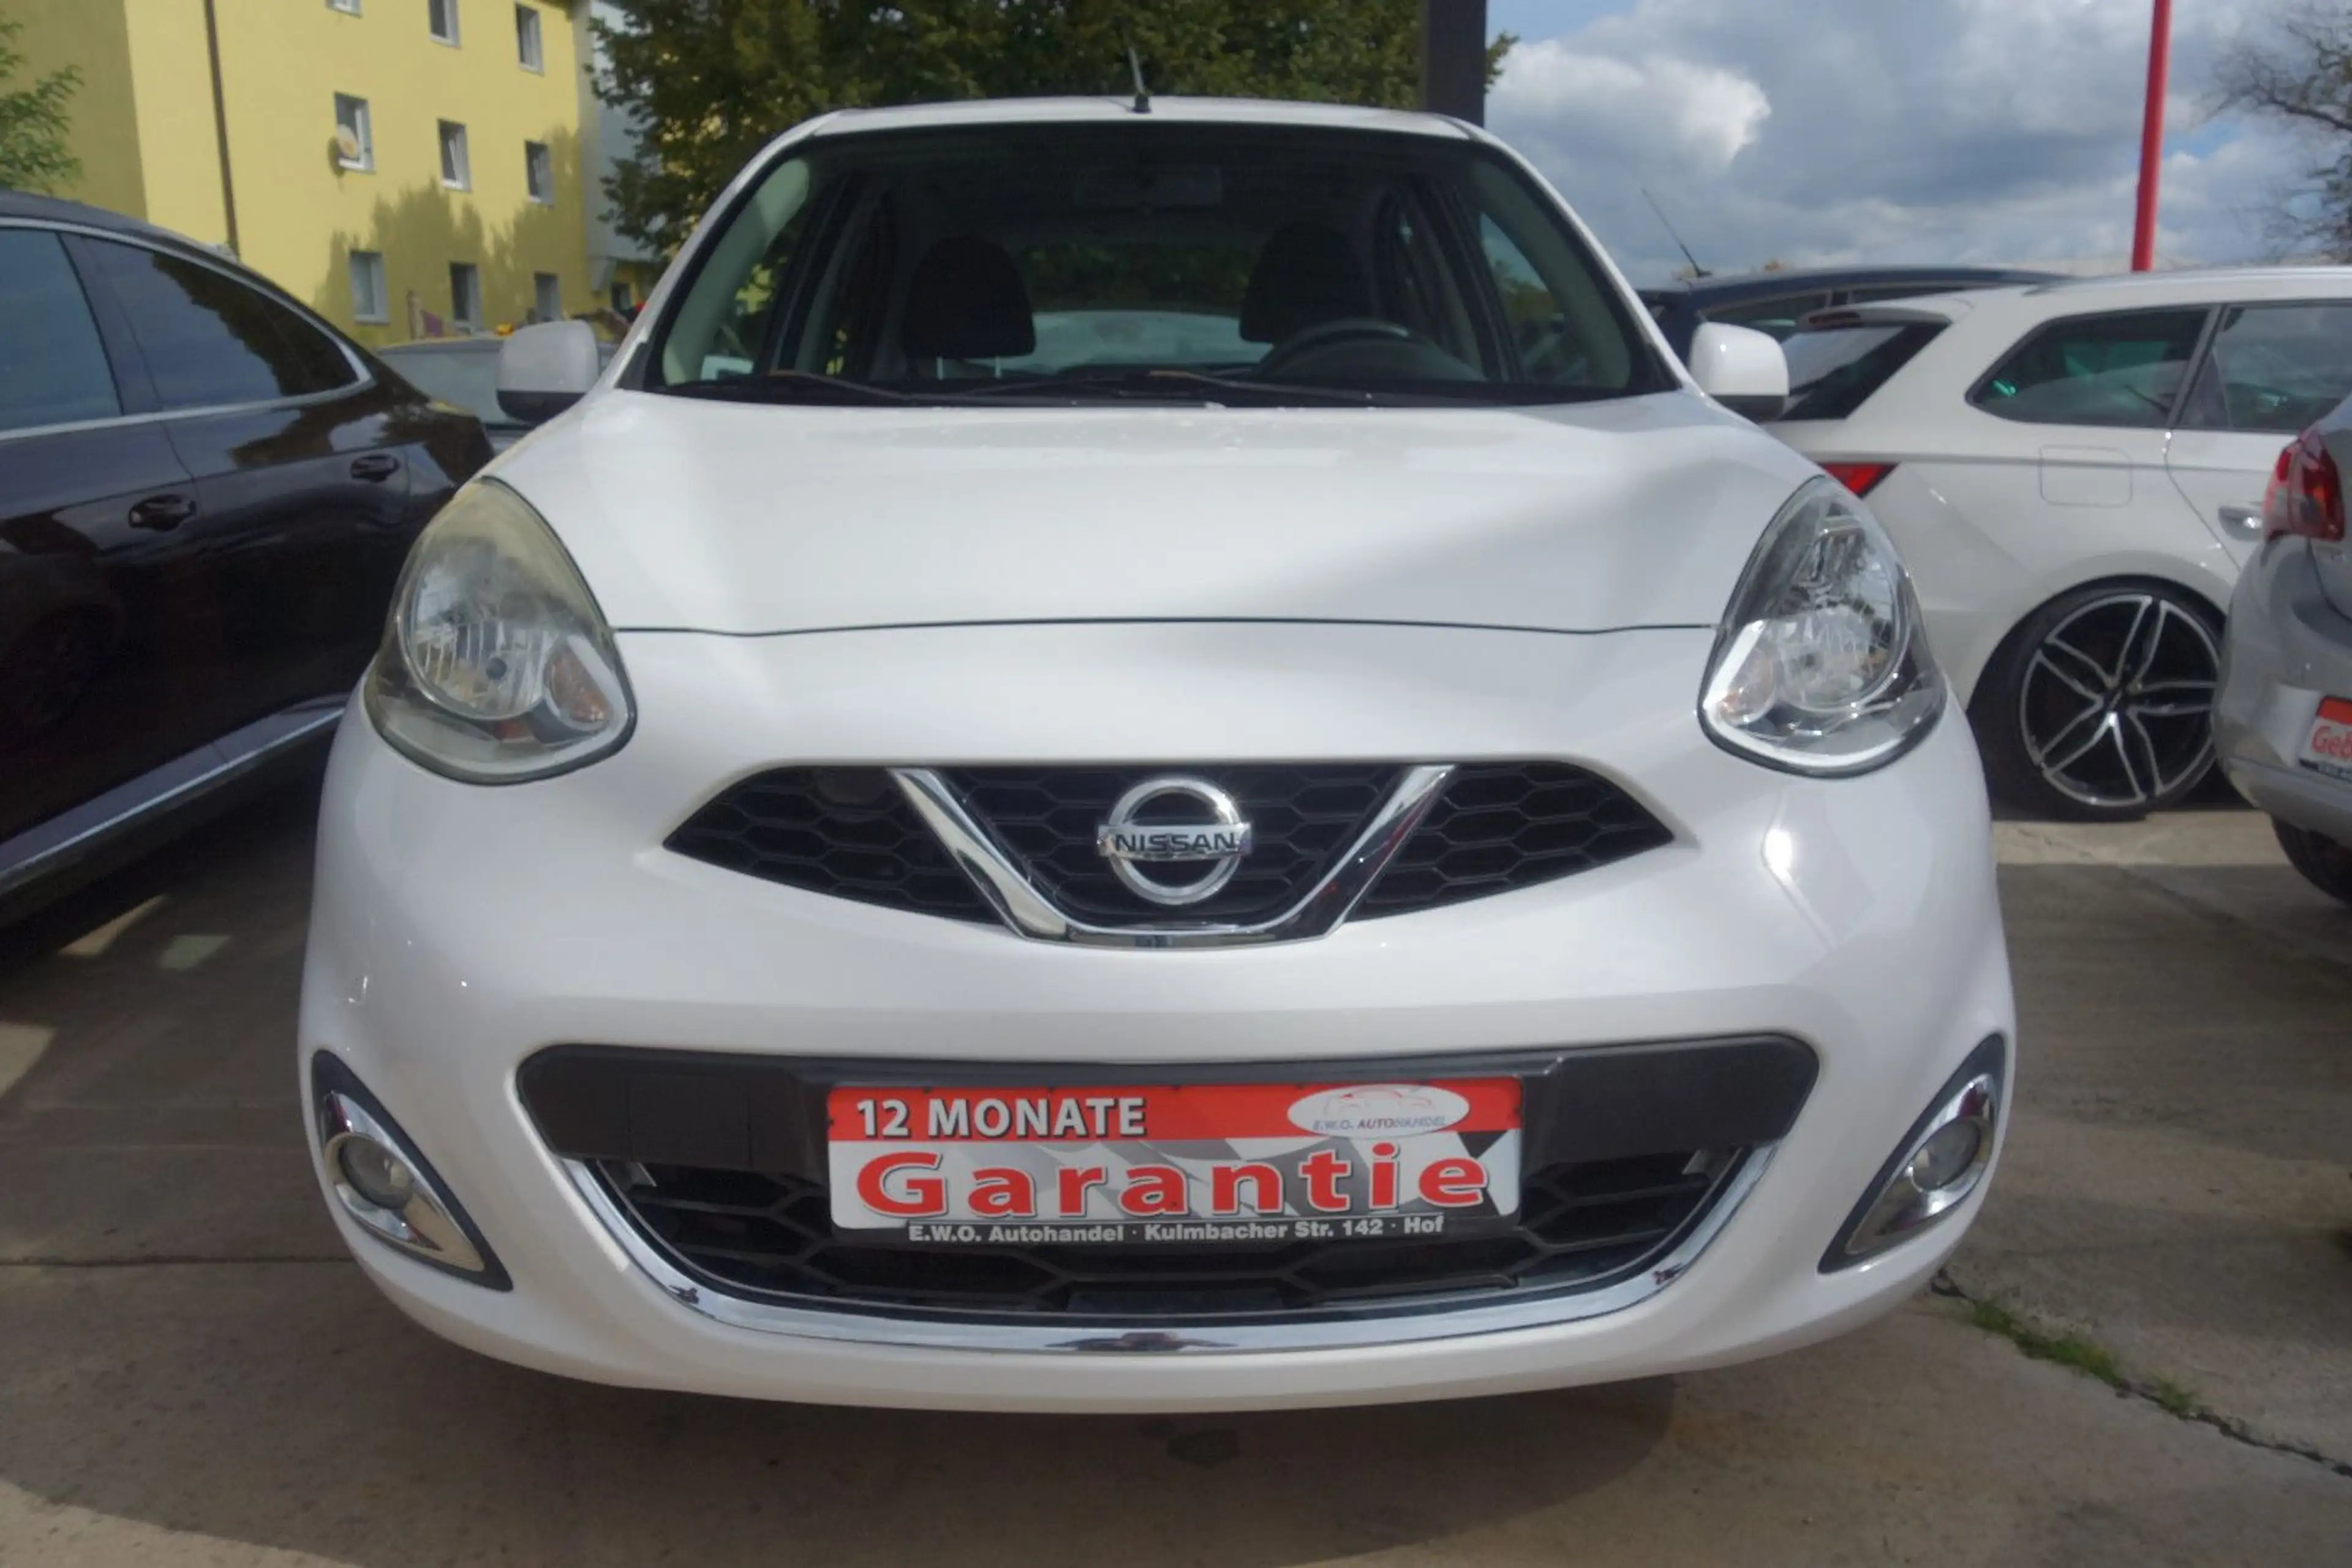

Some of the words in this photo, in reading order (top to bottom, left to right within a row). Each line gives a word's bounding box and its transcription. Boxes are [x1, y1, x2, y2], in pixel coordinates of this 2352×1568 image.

[1114, 832, 1237, 853] NISSAN
[857, 1098, 910, 1137] 12
[928, 1097, 1147, 1138] MONATE
[856, 1142, 1488, 1217] Garantie
[908, 1224, 982, 1242] E.W.O.
[988, 1225, 1125, 1242] Autohandel
[1144, 1223, 1288, 1242] Kulmbacher
[1294, 1221, 1335, 1238] Str.
[1344, 1218, 1384, 1236] 142
[1404, 1215, 1445, 1234] Hof
